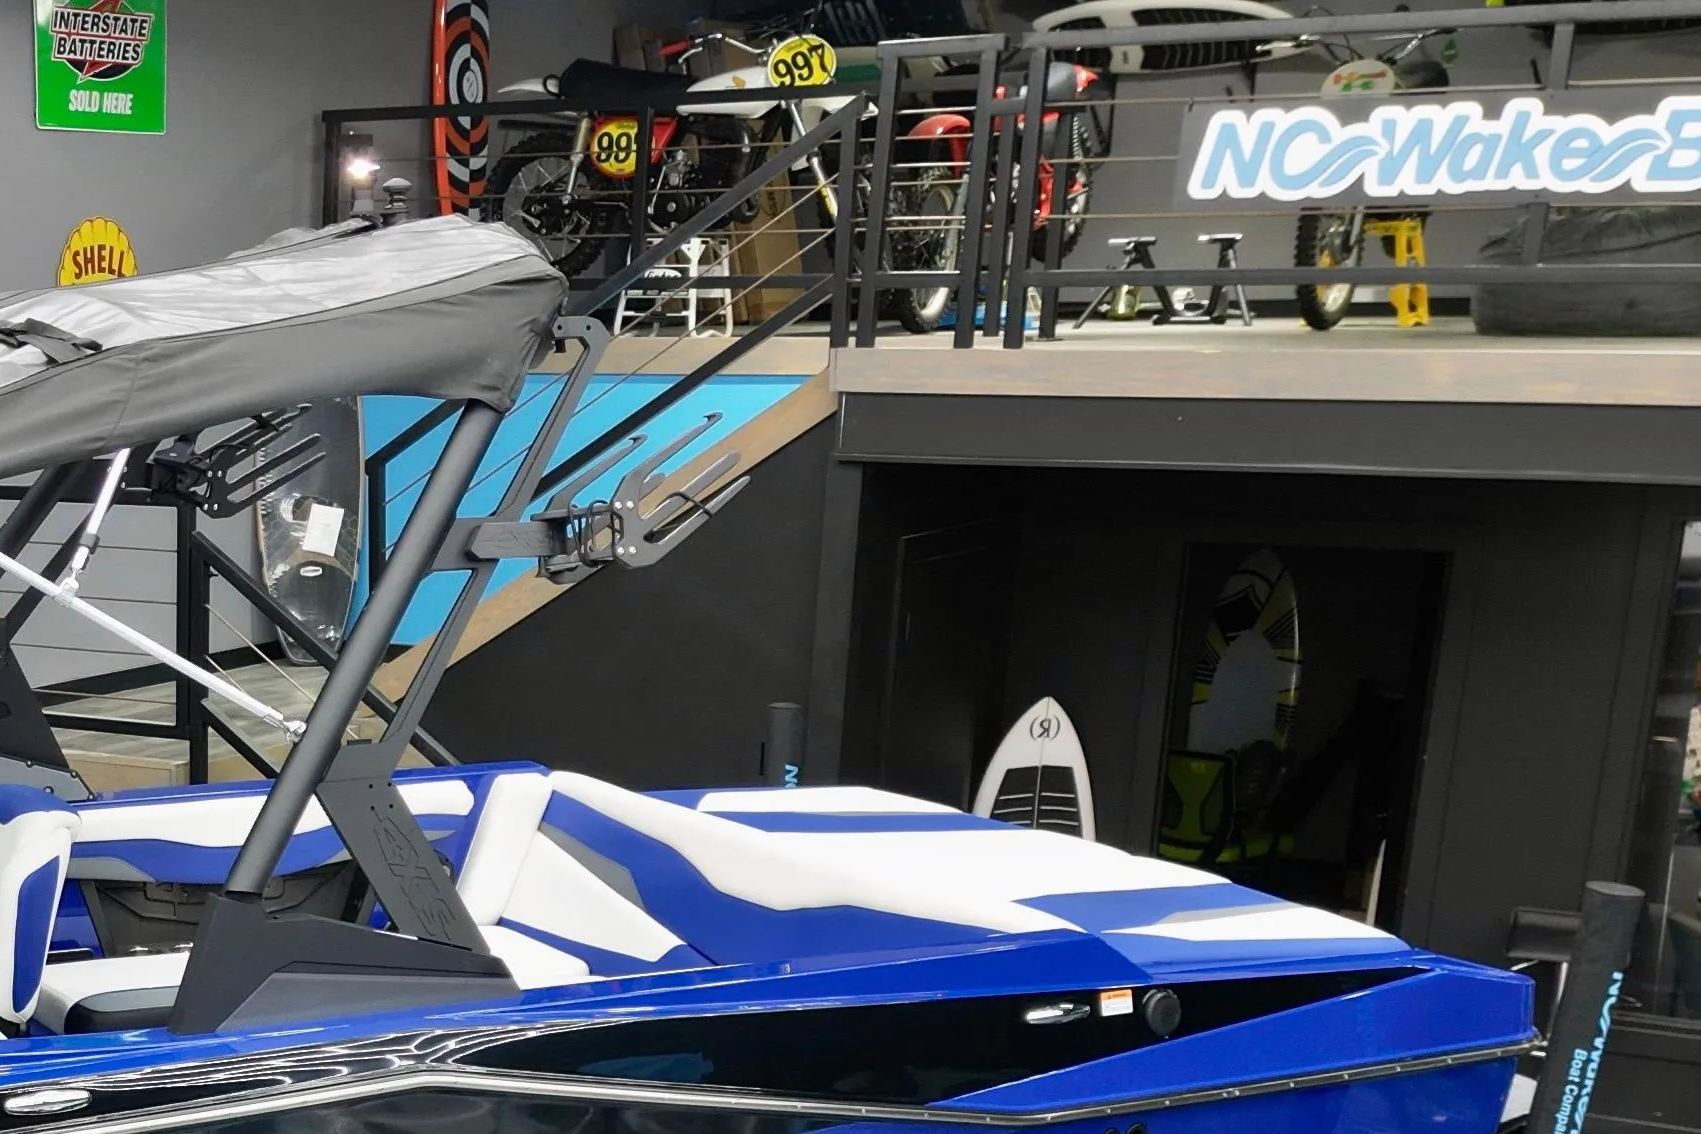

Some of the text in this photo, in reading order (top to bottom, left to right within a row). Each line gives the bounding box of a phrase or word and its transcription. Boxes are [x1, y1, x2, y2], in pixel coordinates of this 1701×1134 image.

[53, 9, 148, 38] INTERSTATE
[56, 36, 141, 62] BATTERIES
[773, 42, 829, 88] 997
[68, 88, 134, 115] SOLD HERE
[596, 131, 639, 164] 99
[1377, 109, 1629, 186] Wake
[71, 244, 127, 280] SHELL
[1568, 1047, 1589, 1083] Boat
